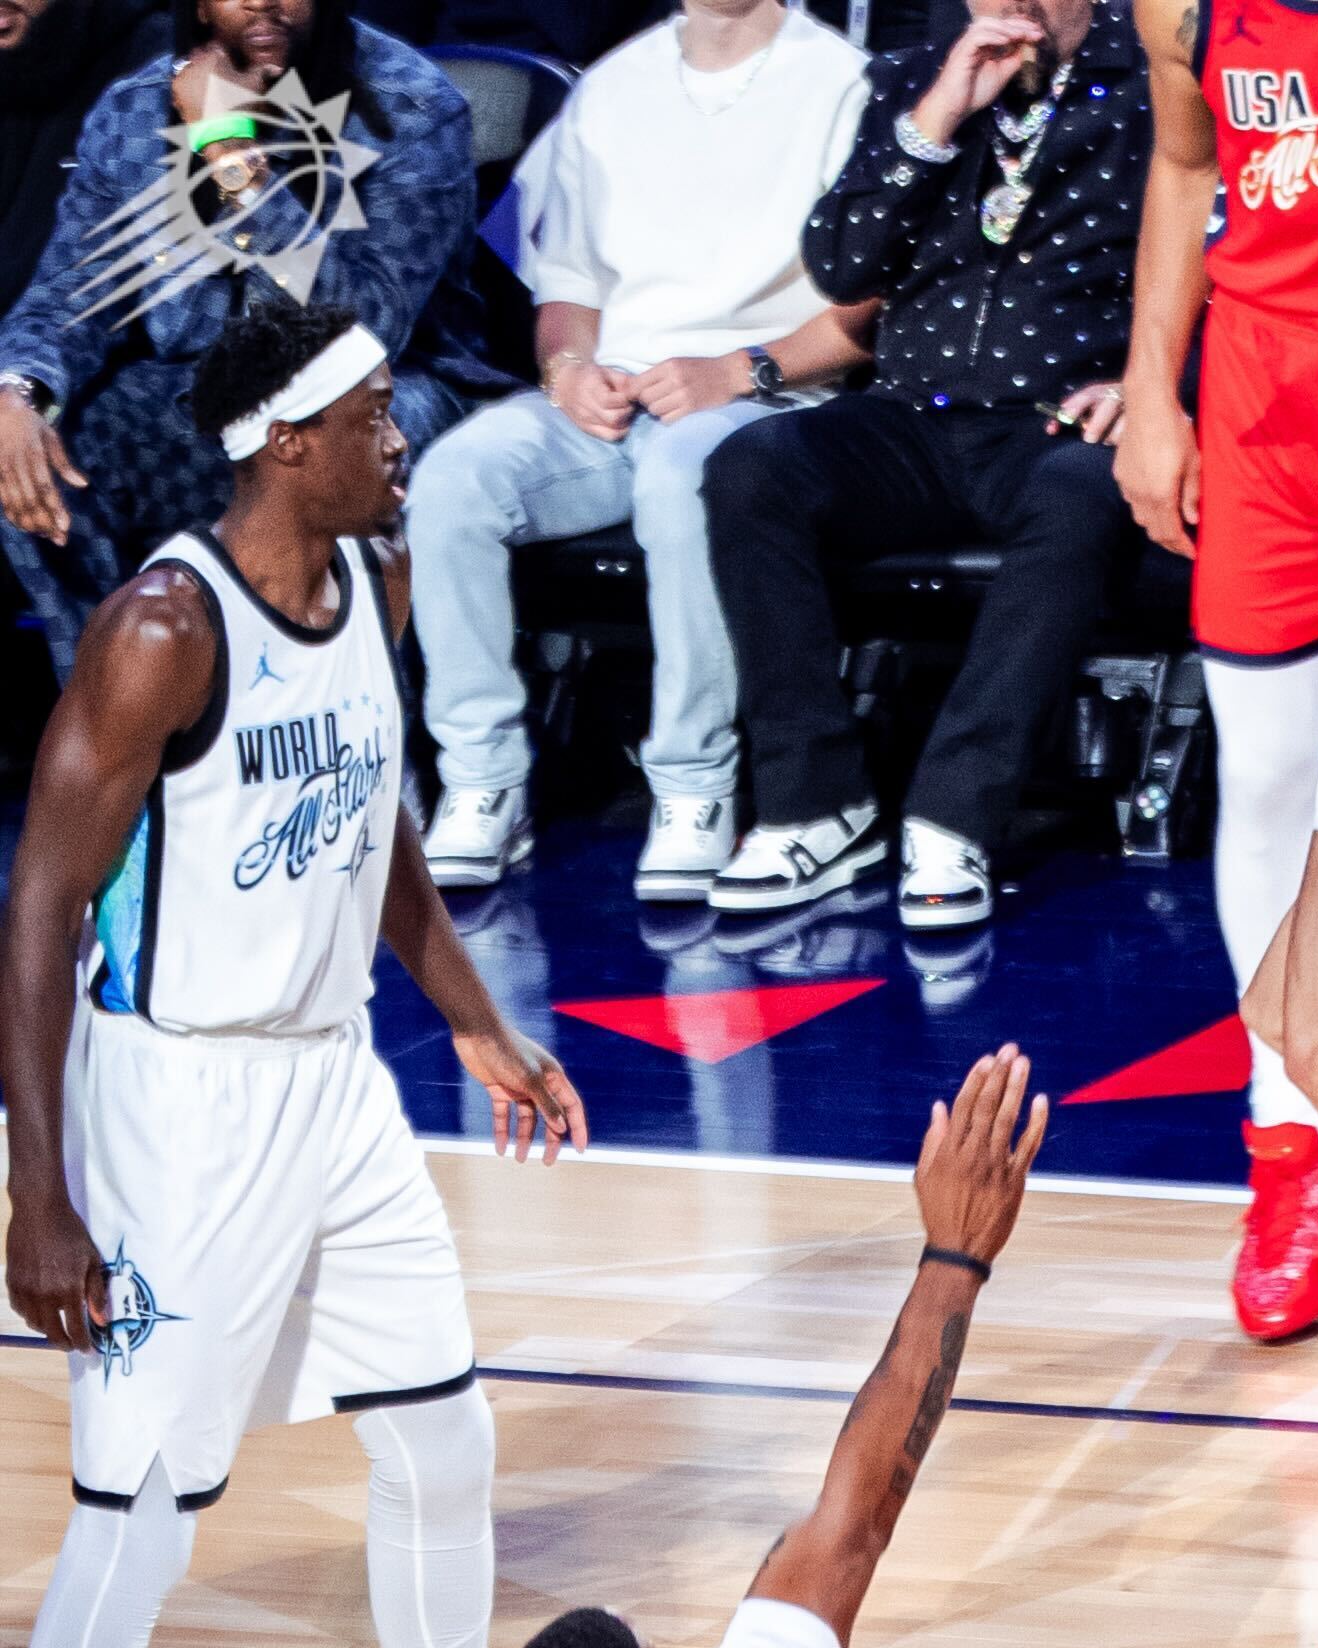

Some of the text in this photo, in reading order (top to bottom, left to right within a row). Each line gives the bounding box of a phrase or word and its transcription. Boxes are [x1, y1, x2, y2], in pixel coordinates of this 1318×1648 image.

[1221, 69, 1317, 133] USA
[1239, 134, 1314, 211] All
[234, 712, 338, 785] WORLD
[234, 789, 323, 890] All
